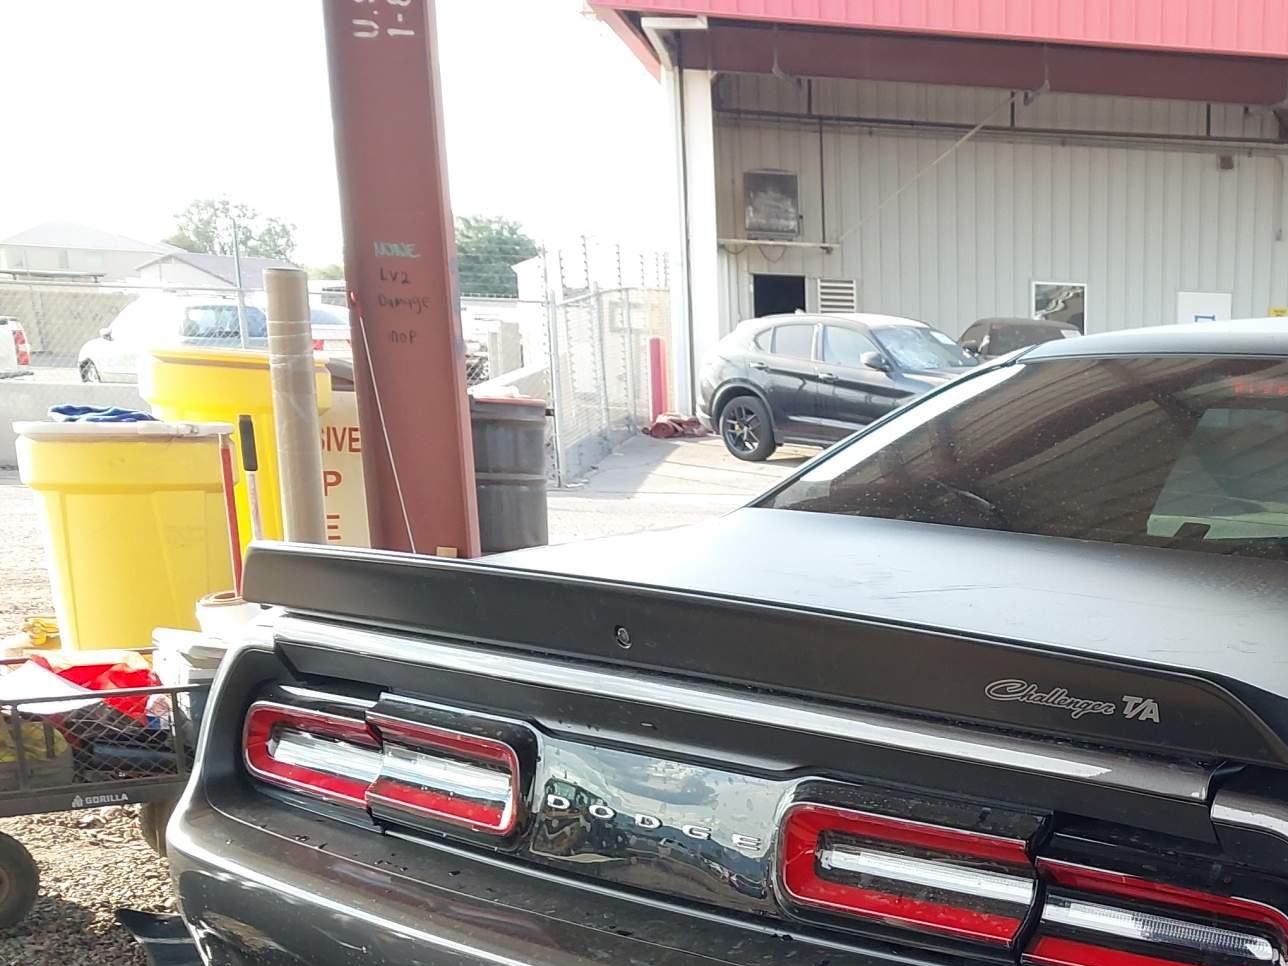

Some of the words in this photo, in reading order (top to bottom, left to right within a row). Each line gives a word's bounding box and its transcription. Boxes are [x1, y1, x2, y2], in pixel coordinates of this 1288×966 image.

[985, 679, 1116, 719] Challenger
[84, 792, 129, 805] GORILLA
[547, 794, 761, 851] DODGE
